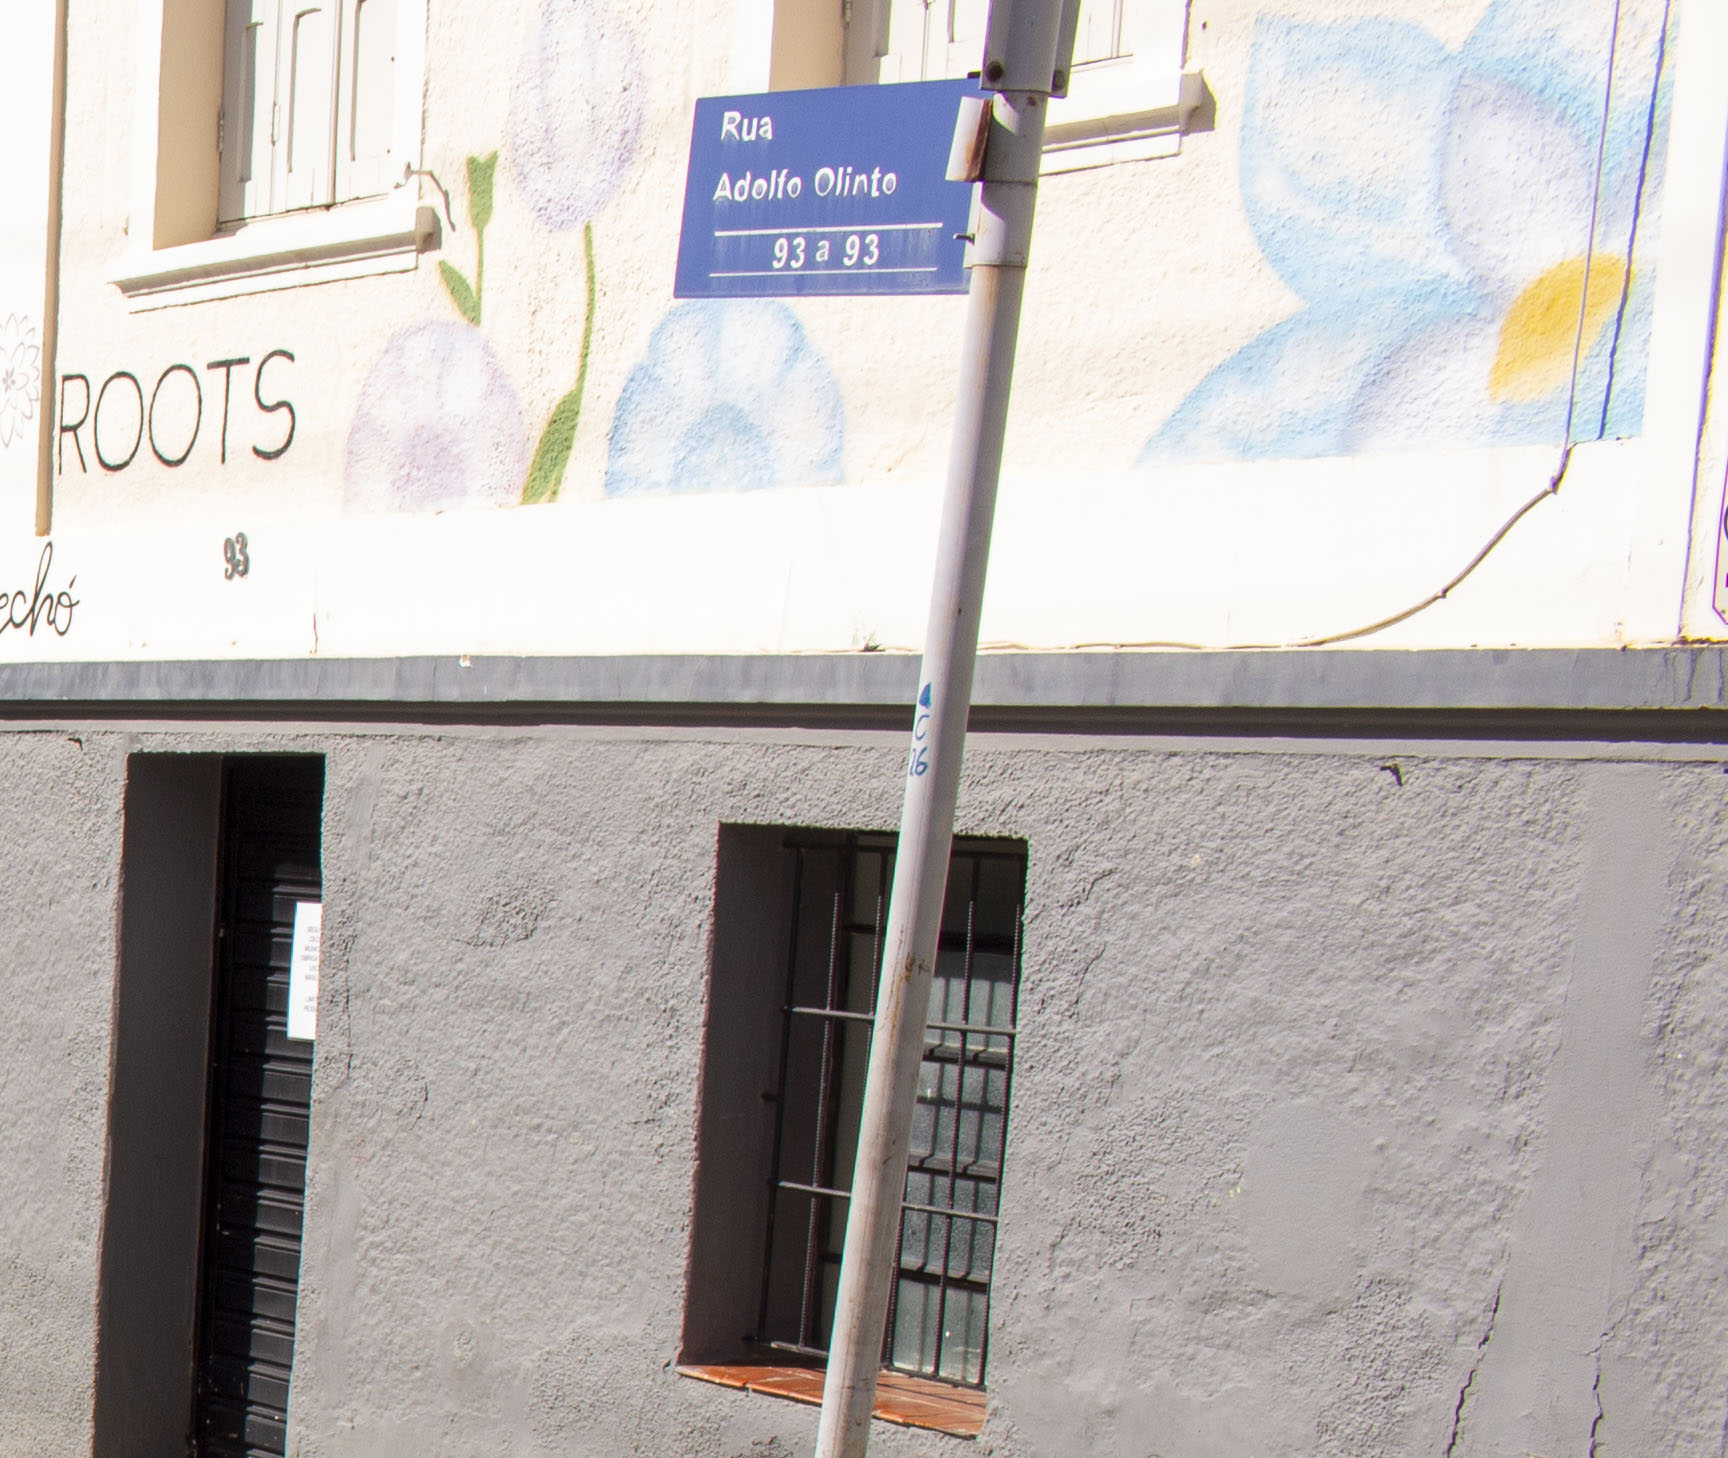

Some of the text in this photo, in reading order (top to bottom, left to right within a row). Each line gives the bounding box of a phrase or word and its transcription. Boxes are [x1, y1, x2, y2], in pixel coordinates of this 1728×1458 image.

[721, 111, 773, 142] Rua
[713, 166, 897, 201] Adolfo Olinto
[772, 234, 880, 268] 93 a 93
[58, 349, 296, 476] ROOTS
[223, 531, 250, 580] 93
